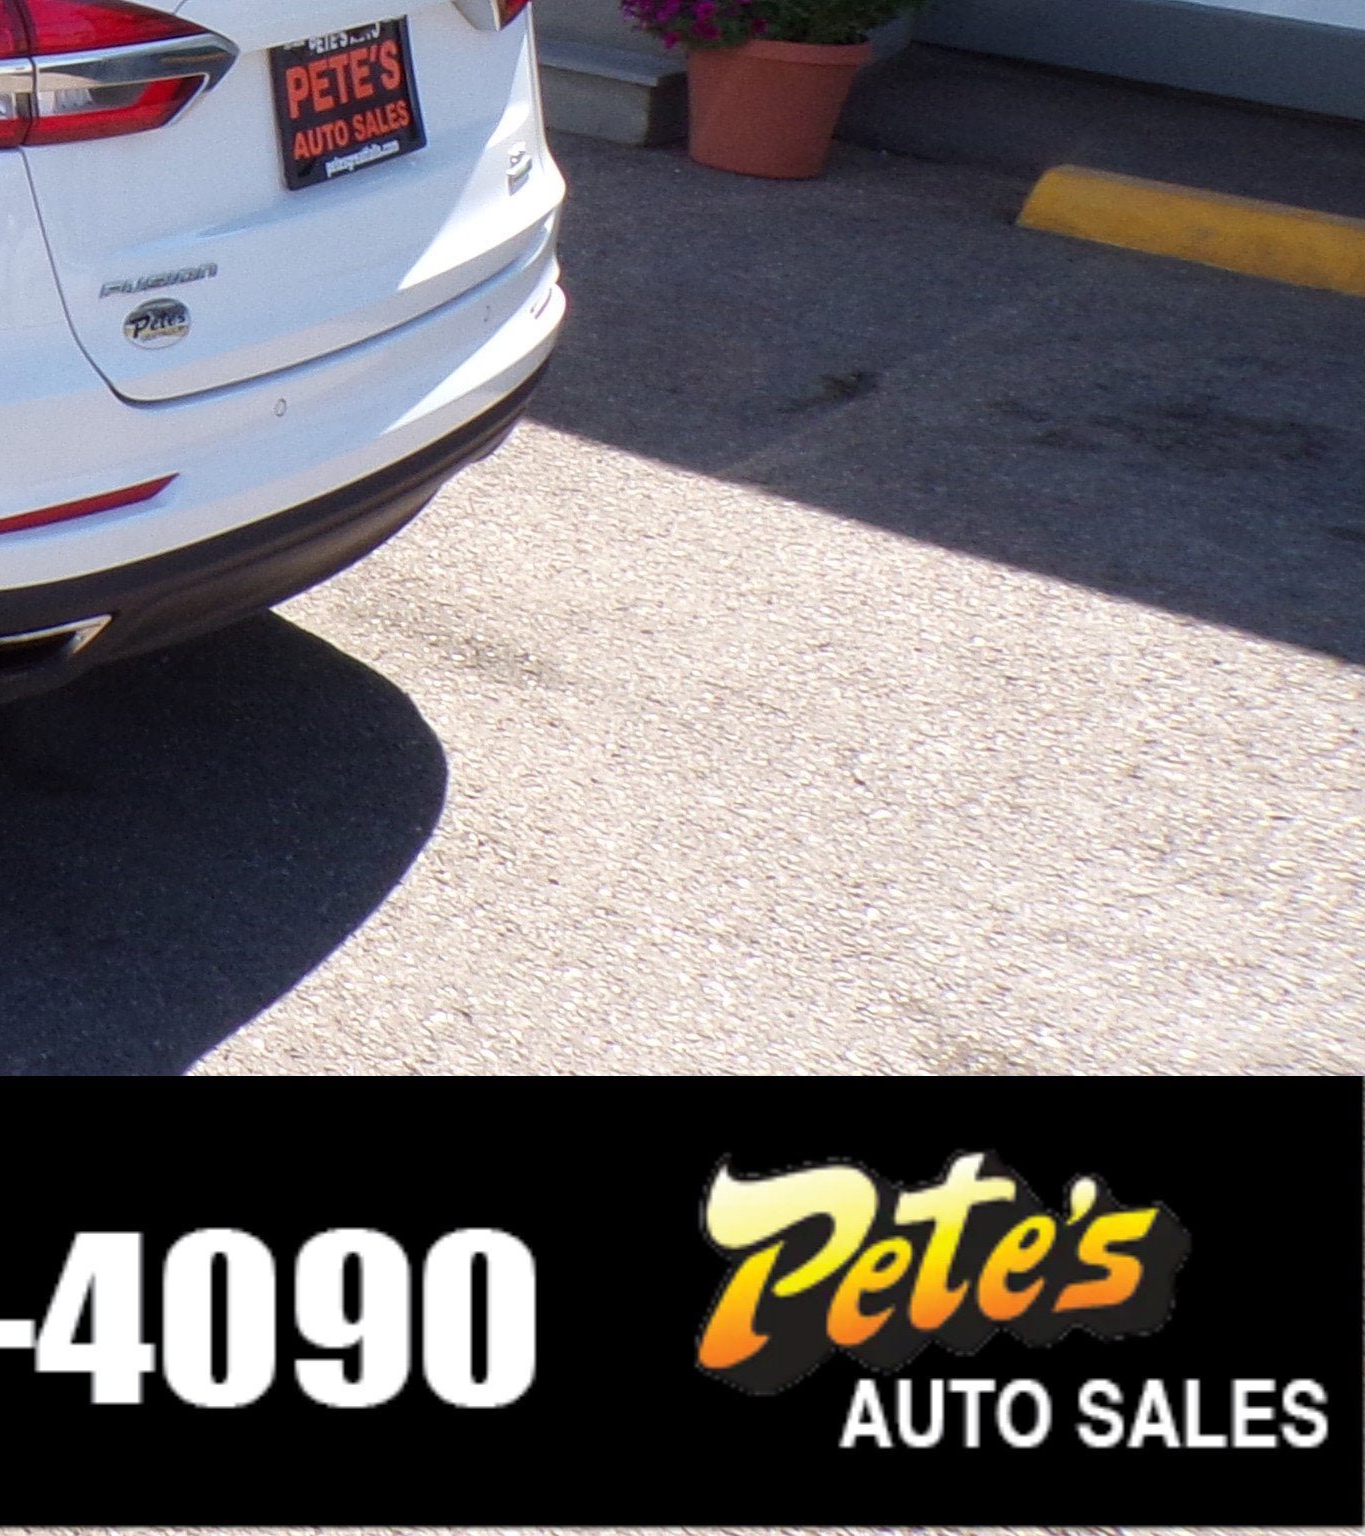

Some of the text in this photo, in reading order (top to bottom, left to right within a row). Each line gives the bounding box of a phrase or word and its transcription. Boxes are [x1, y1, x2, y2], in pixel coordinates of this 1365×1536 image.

[285, 39, 402, 121] PETE'S
[292, 119, 350, 161] AUTO
[351, 99, 411, 142] SALES
